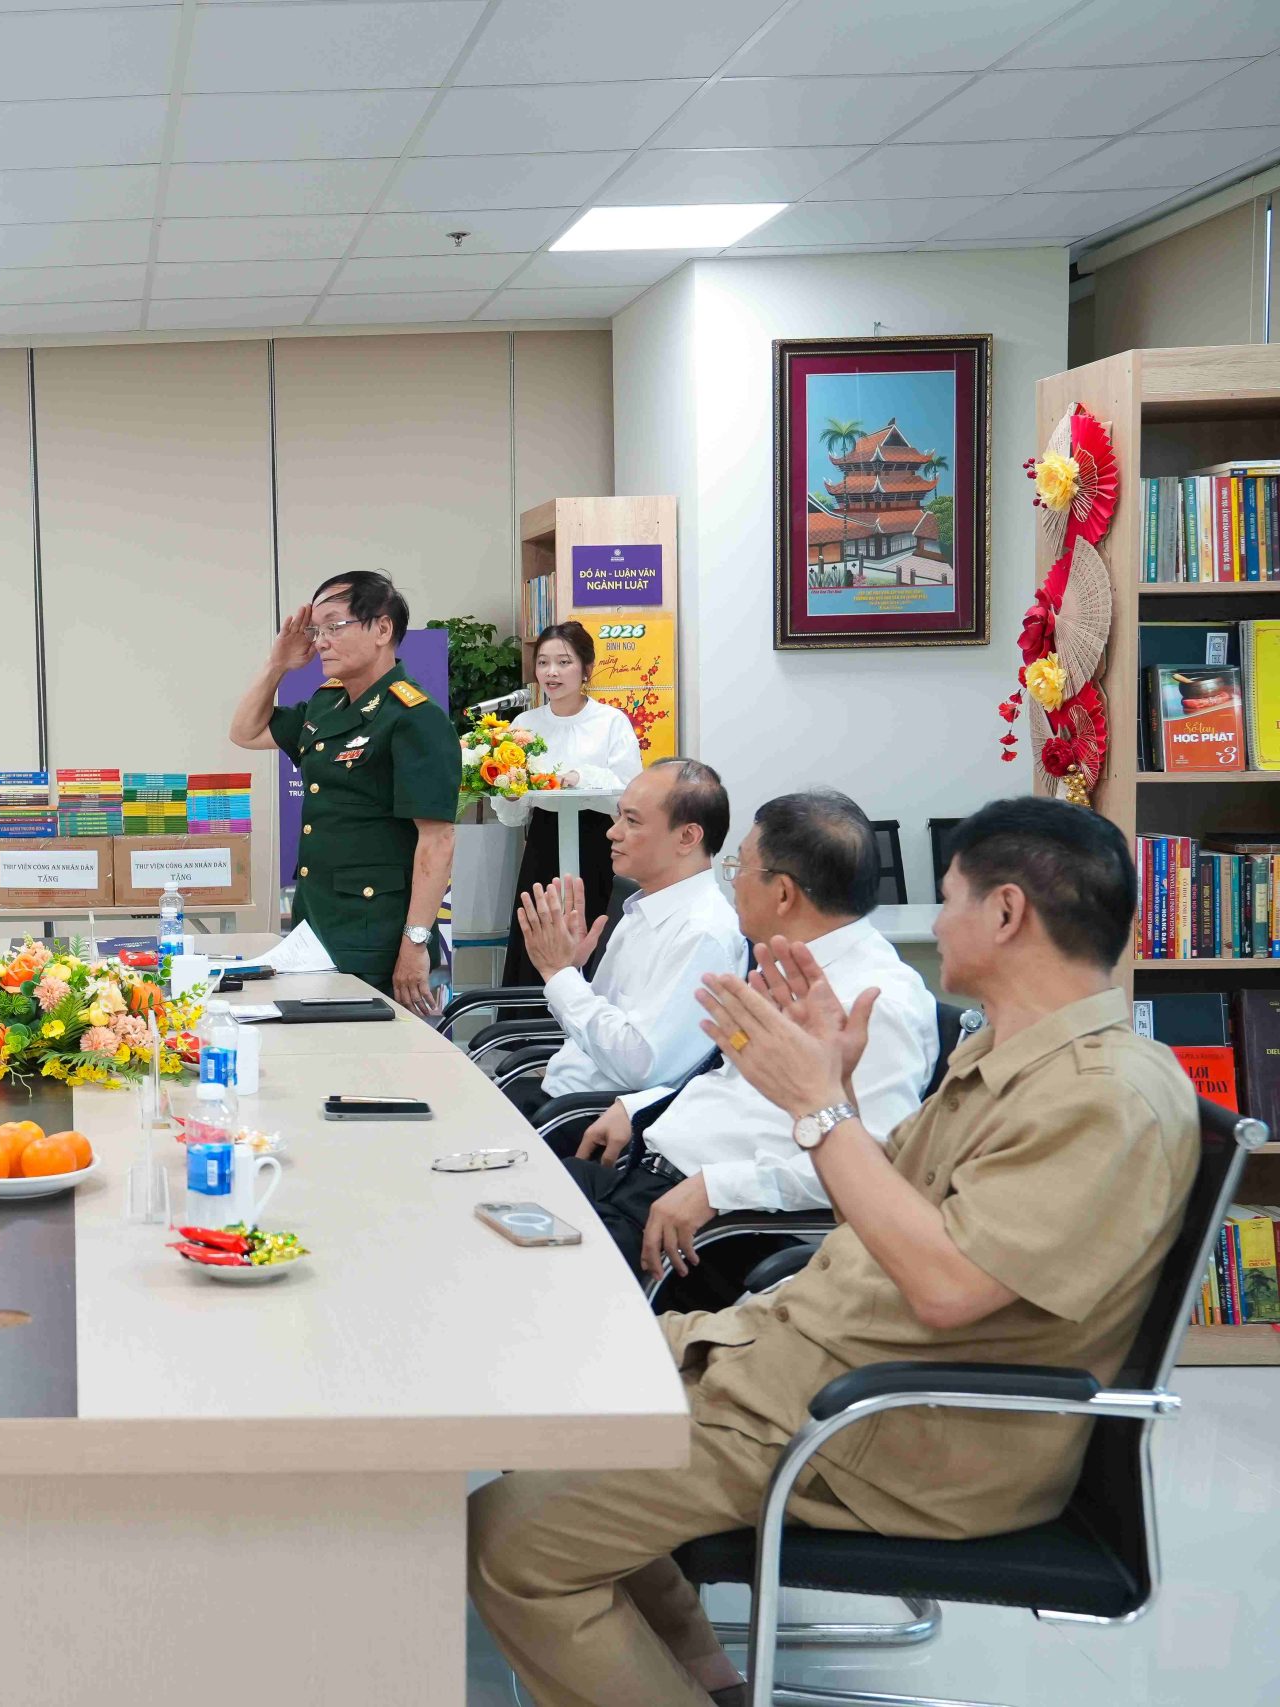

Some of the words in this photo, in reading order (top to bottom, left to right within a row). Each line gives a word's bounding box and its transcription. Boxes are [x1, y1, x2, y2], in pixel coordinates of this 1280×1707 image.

[614, 568, 636, 579] LUẬN
[638, 568, 656, 577] VĂN
[587, 579, 622, 590] NGÀNH
[624, 578, 648, 591] LUẬT
[598, 624, 646, 639] 2026
[1219, 746, 1236, 764] 3
[37, 875, 59, 883] TẶNG
[170, 873, 192, 882] TẶNG
